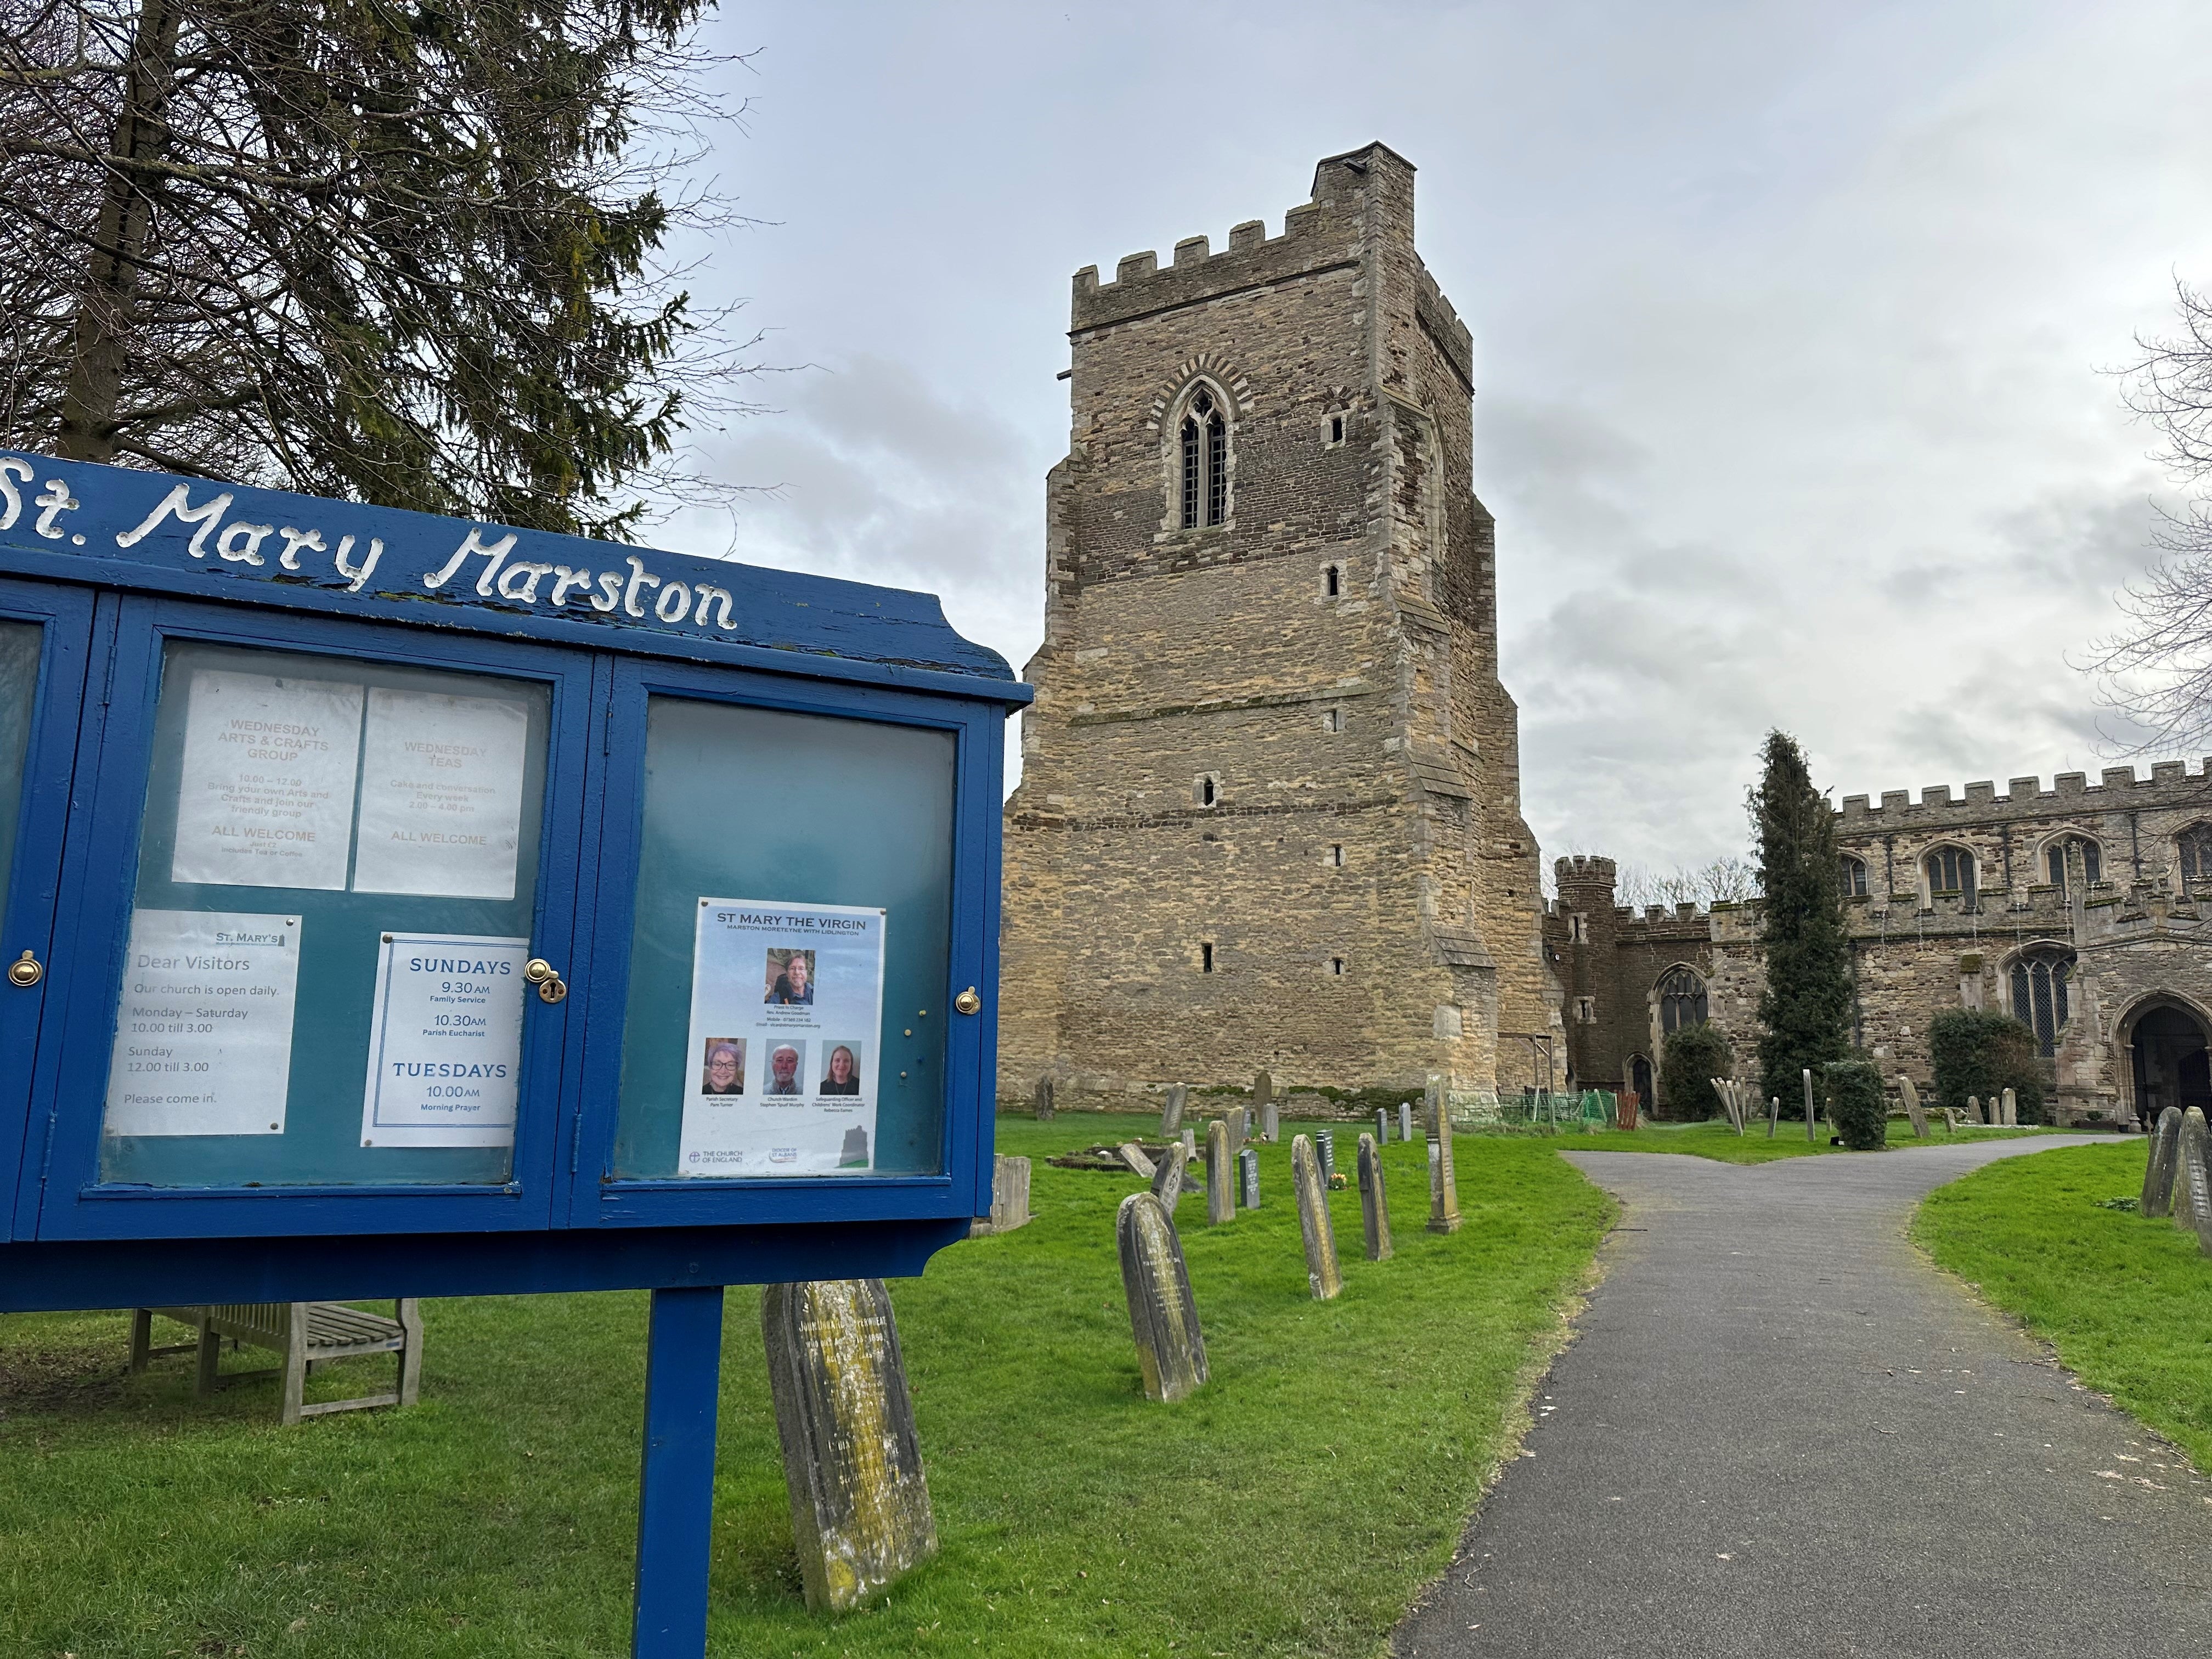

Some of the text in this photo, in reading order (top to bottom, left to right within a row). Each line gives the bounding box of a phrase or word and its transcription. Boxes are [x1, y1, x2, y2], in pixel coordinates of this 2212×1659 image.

[0, 456, 738, 630] St. Mary Marston
[230, 719, 320, 736] WEDNESDAY
[218, 732, 329, 751] ARTS & CRAFTS
[247, 748, 298, 761] GROUP
[404, 741, 487, 757] WEDNESDAY
[428, 757, 462, 768] TEAS
[239, 774, 264, 783] 10.00
[276, 777, 302, 787] 12.00
[390, 780, 495, 794] Cake and conversation
[207, 782, 329, 799] Bring your own Arts and
[416, 791, 469, 803] Every week
[221, 794, 314, 808] Crafts and join our
[231, 805, 302, 819] friendly group
[438, 803, 458, 811] 4.00
[460, 805, 474, 813] pm
[212, 825, 316, 842] ALL WELCOME
[391, 831, 487, 845] ALL WELCOME
[717, 912, 866, 930] ST MARY THE VIRGIN
[138, 955, 250, 970] Dear Visitors
[409, 957, 511, 975] SUNDAYS
[134, 984, 280, 997] Our church is open daily.
[442, 981, 490, 994] 9.30 AM
[430, 995, 455, 1004] Family
[133, 1007, 182, 1019] Monday
[196, 1008, 248, 1020] Saturday
[131, 1022, 212, 1034] 10.00 till 3.00
[128, 1047, 173, 1058] Sunday
[127, 1062, 208, 1072] 12.00 till 3.00
[392, 1062, 507, 1078] TUESDAYS
[124, 1093, 163, 1104] Please
[421, 1104, 481, 1113] Morning Prayer
